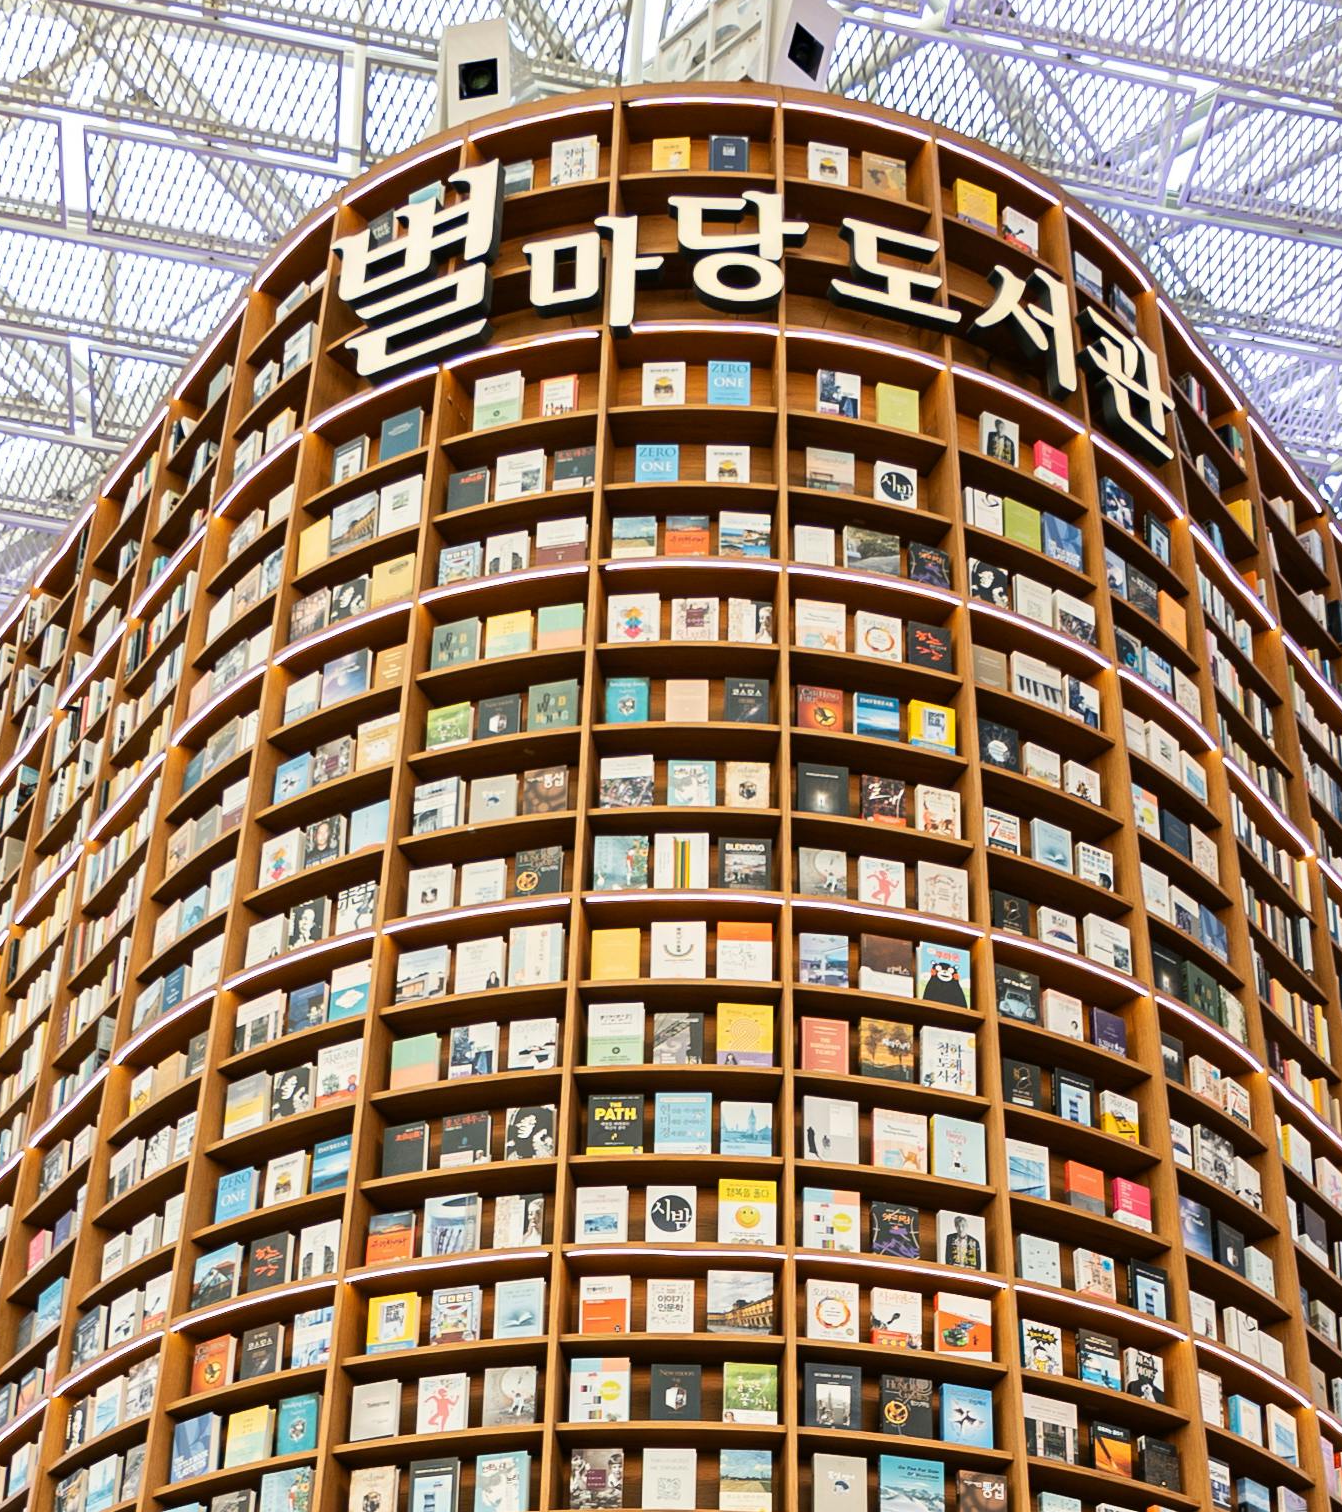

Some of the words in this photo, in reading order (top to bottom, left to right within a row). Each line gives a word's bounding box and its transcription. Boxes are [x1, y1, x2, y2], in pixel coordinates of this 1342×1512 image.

[333, 157, 1172, 461] 별마당도서관
[711, 363, 749, 374] ZERO
[713, 376, 745, 388] ONE
[639, 446, 677, 457] ZERO
[641, 461, 674, 473] ONE
[725, 842, 766, 852] BLENDING
[594, 1107, 638, 1121] PATH
[221, 1170, 251, 1191] ZERO
[221, 1191, 246, 1208] ONE
[657, 1295, 684, 1304] 이야기
[982, 1481, 1005, 1500] 통섭
